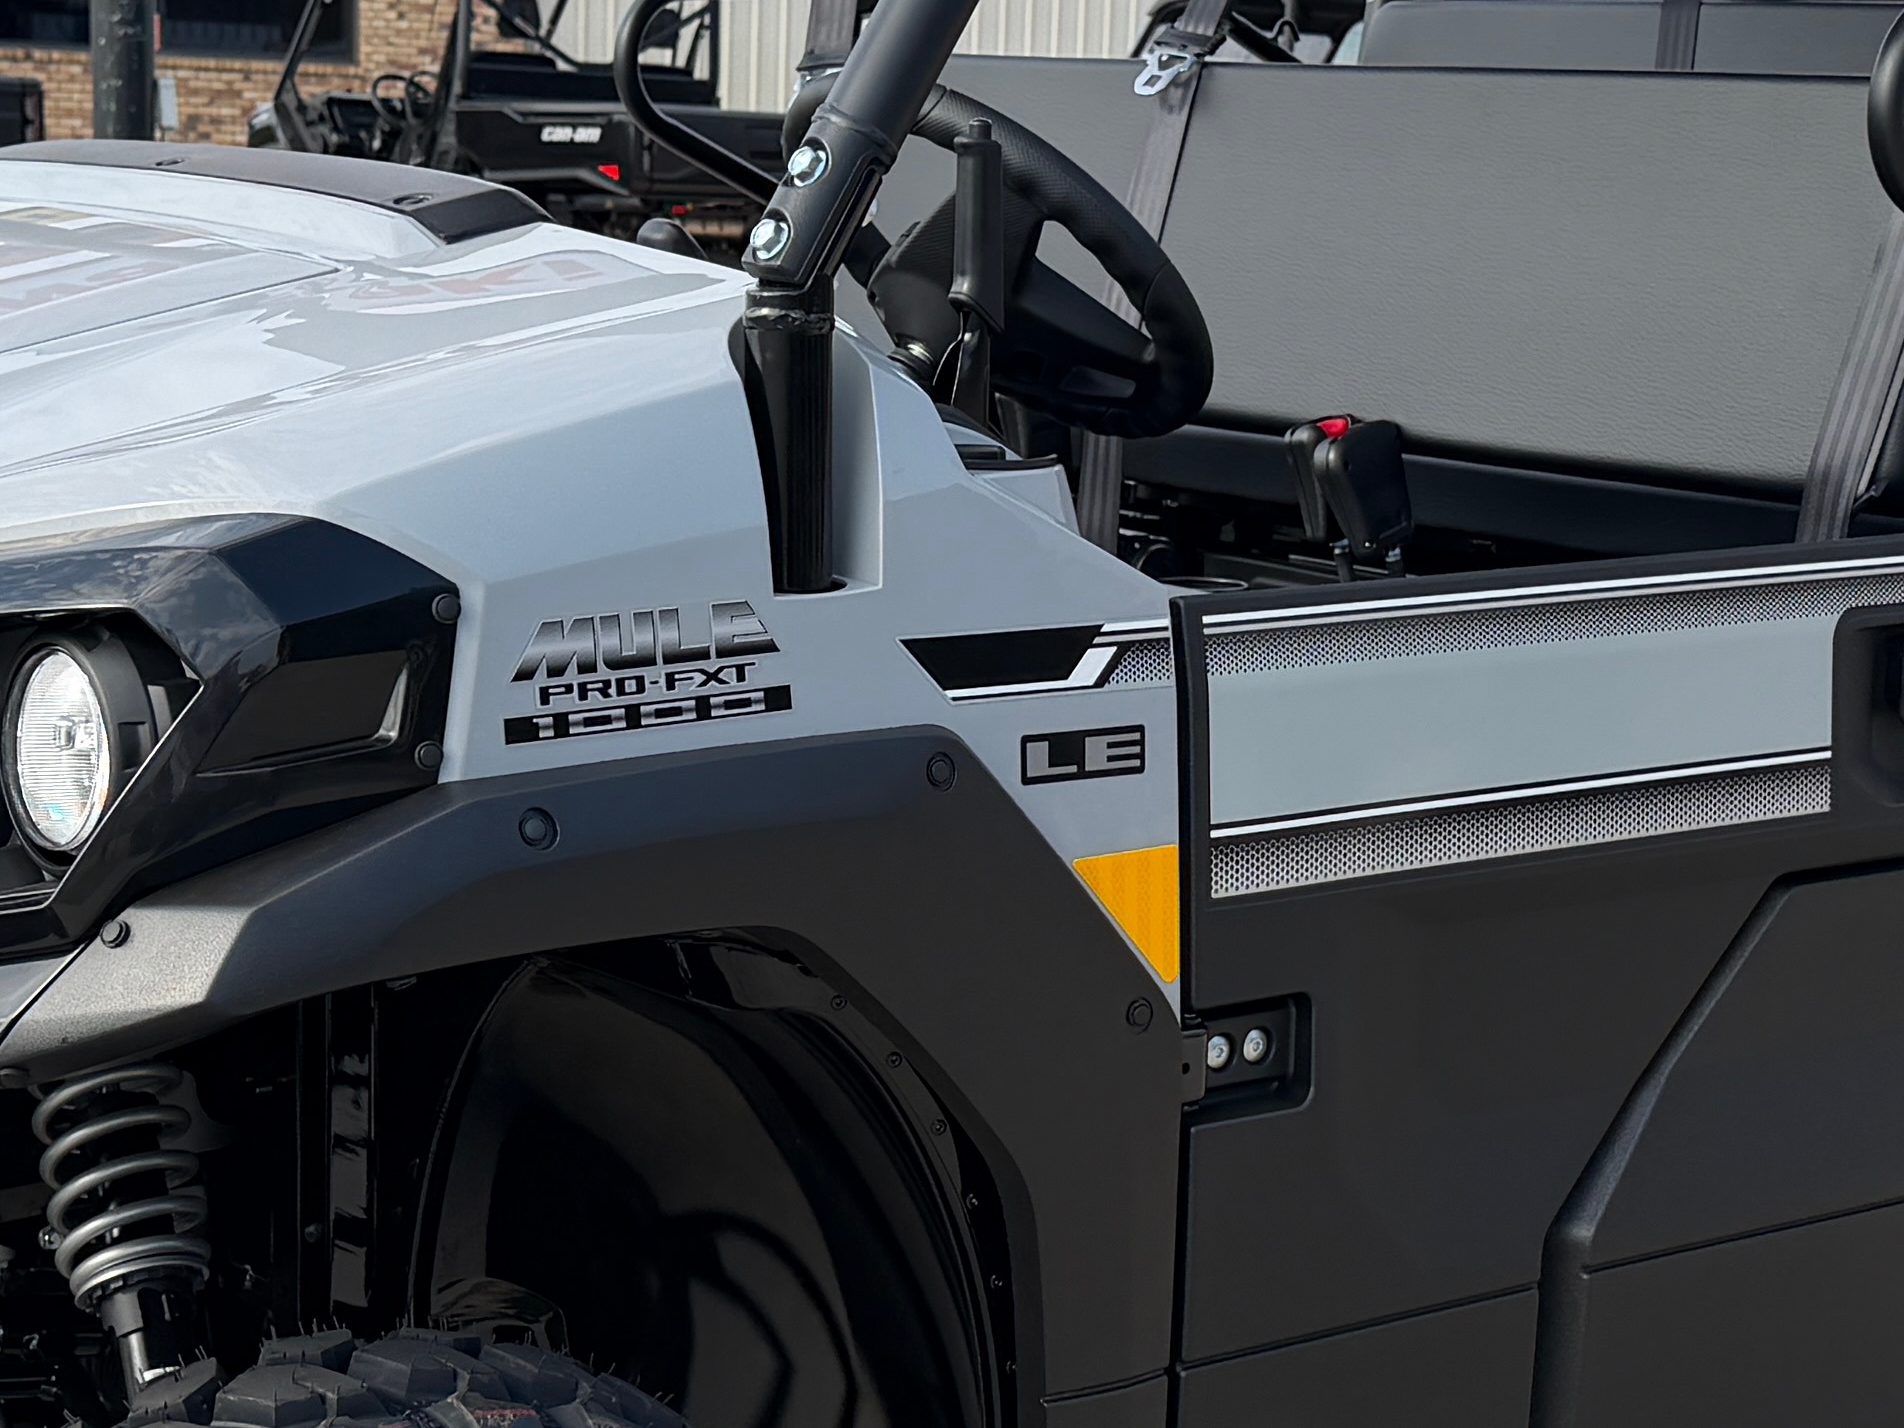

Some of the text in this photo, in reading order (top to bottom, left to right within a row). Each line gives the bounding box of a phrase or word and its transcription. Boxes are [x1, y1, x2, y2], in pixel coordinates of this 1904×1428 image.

[509, 599, 782, 684] MULE
[537, 661, 758, 707] PRO-FXT
[532, 689, 767, 740] 1000
[1026, 730, 1143, 778] LE
